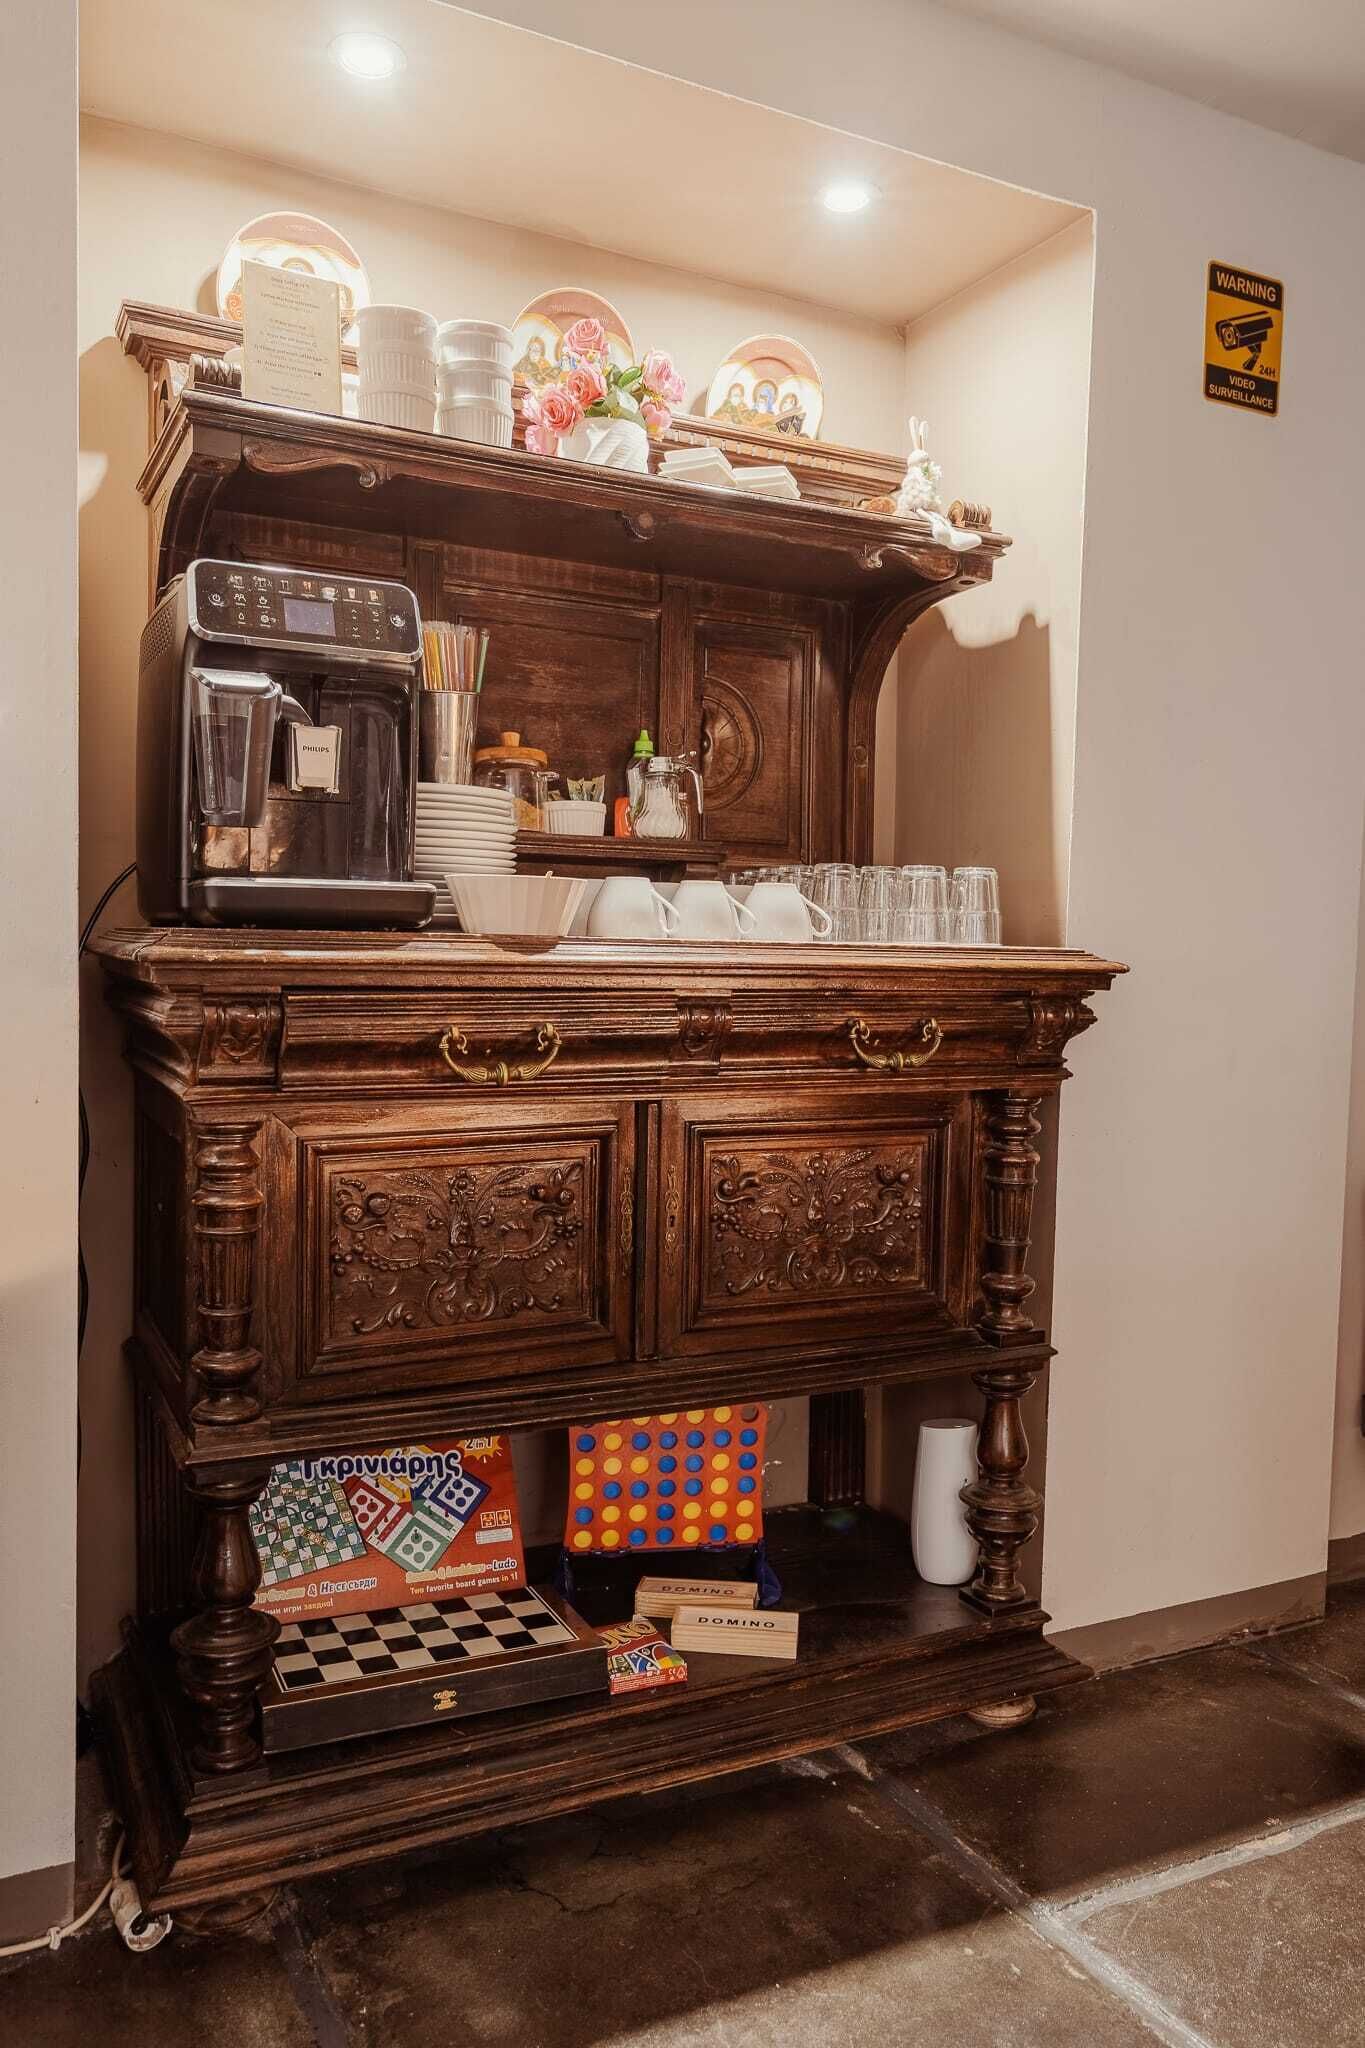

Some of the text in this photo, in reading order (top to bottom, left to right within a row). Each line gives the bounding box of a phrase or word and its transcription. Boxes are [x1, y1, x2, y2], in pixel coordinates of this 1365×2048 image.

[1215, 270, 1277, 302] WARNING
[1259, 364, 1276, 378] 24H
[1229, 375, 1256, 391] VIDEO
[1209, 383, 1274, 409] SURVEILLANCE
[302, 744, 330, 753] PHILIPS
[493, 1559, 517, 1570] Ludo
[426, 1583, 454, 1593] favorite
[455, 1579, 476, 1589] board
[478, 1577, 500, 1587] games
[662, 1585, 736, 1595] DOMINO
[698, 1616, 775, 1629] DOMINO
